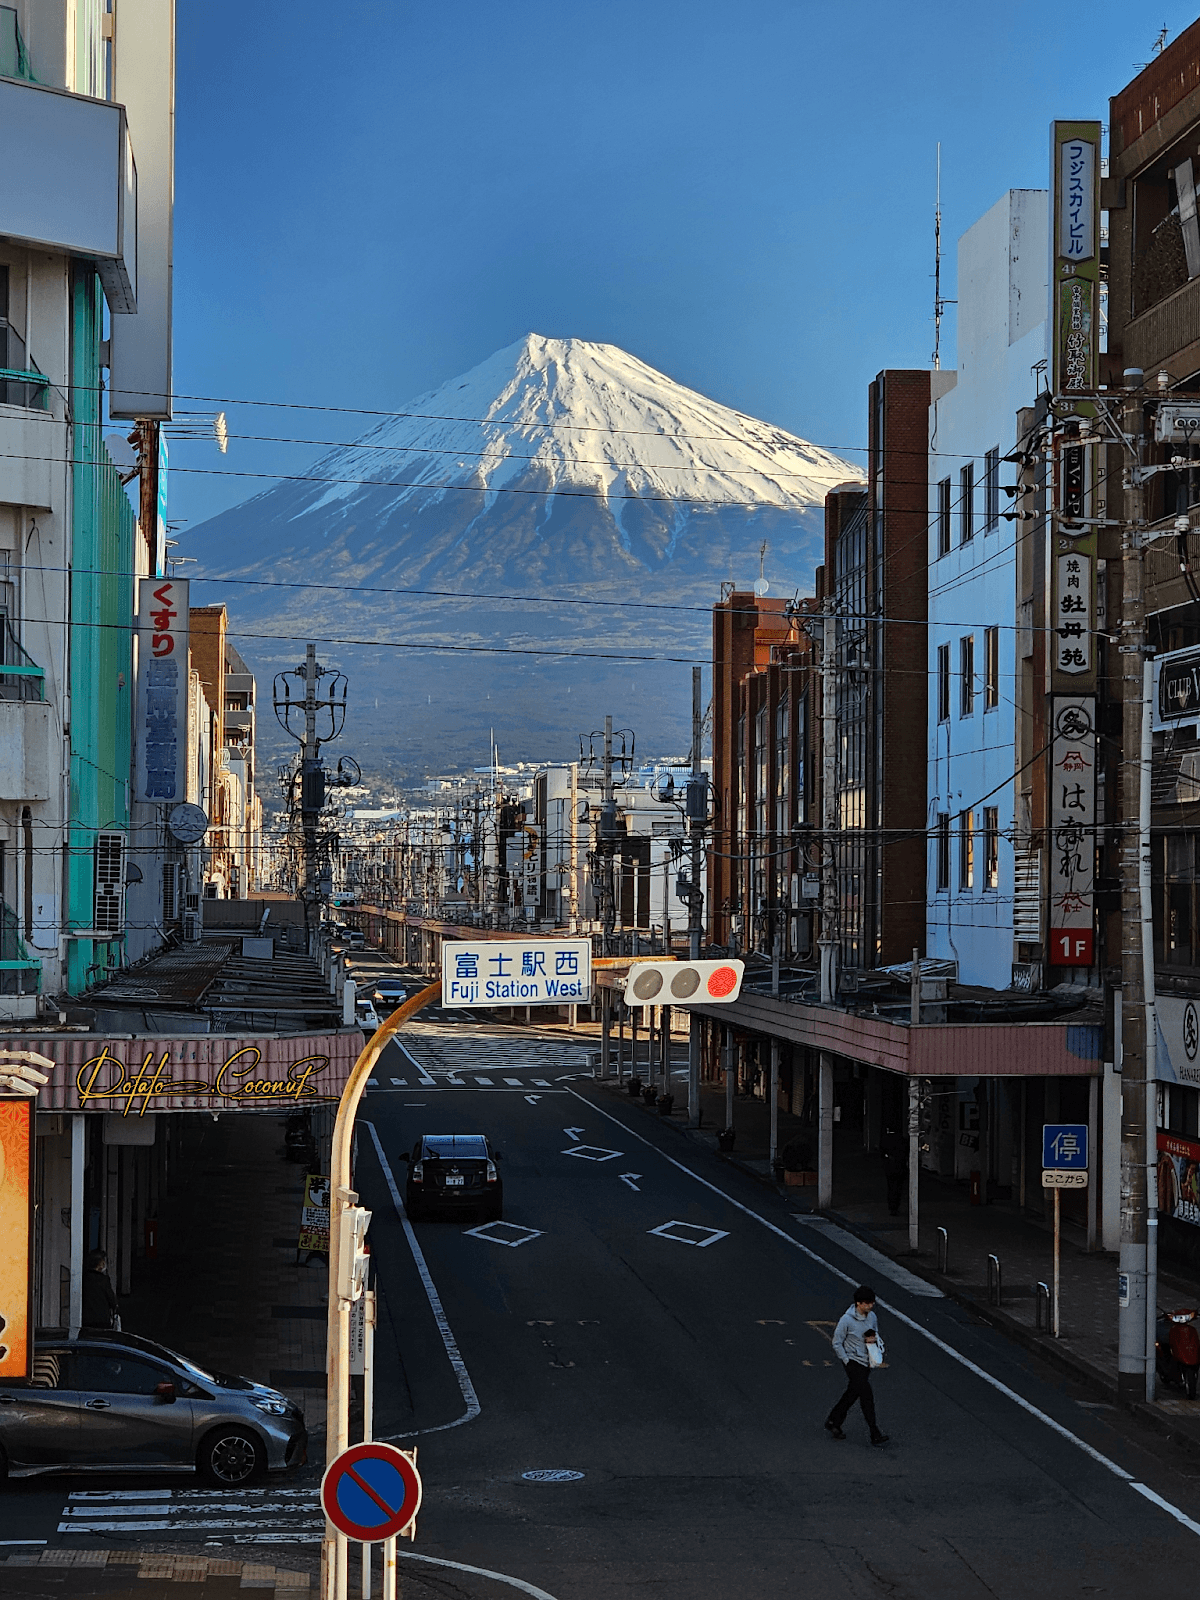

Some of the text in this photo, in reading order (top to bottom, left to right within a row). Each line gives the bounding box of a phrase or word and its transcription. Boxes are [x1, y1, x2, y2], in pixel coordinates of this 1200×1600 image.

[1068, 146, 1085, 254] フジスカイビル
[1061, 264, 1077, 274] 4F
[1066, 332, 1086, 390] 竹取御殿
[1060, 401, 1075, 412] 3F
[1059, 539, 1073, 550] 2F
[149, 582, 178, 658] くすり
[1060, 559, 1087, 667] 焼肉 牡丹苑
[1167, 676, 1191, 700] CLUB
[1061, 903, 1082, 913] 富士
[1059, 936, 1086, 958] 1F
[455, 952, 580, 979] 富士駅西
[451, 978, 583, 1003] Fuji Station West
[1050, 1132, 1081, 1161] 停
[1045, 1174, 1085, 1184] ここから
